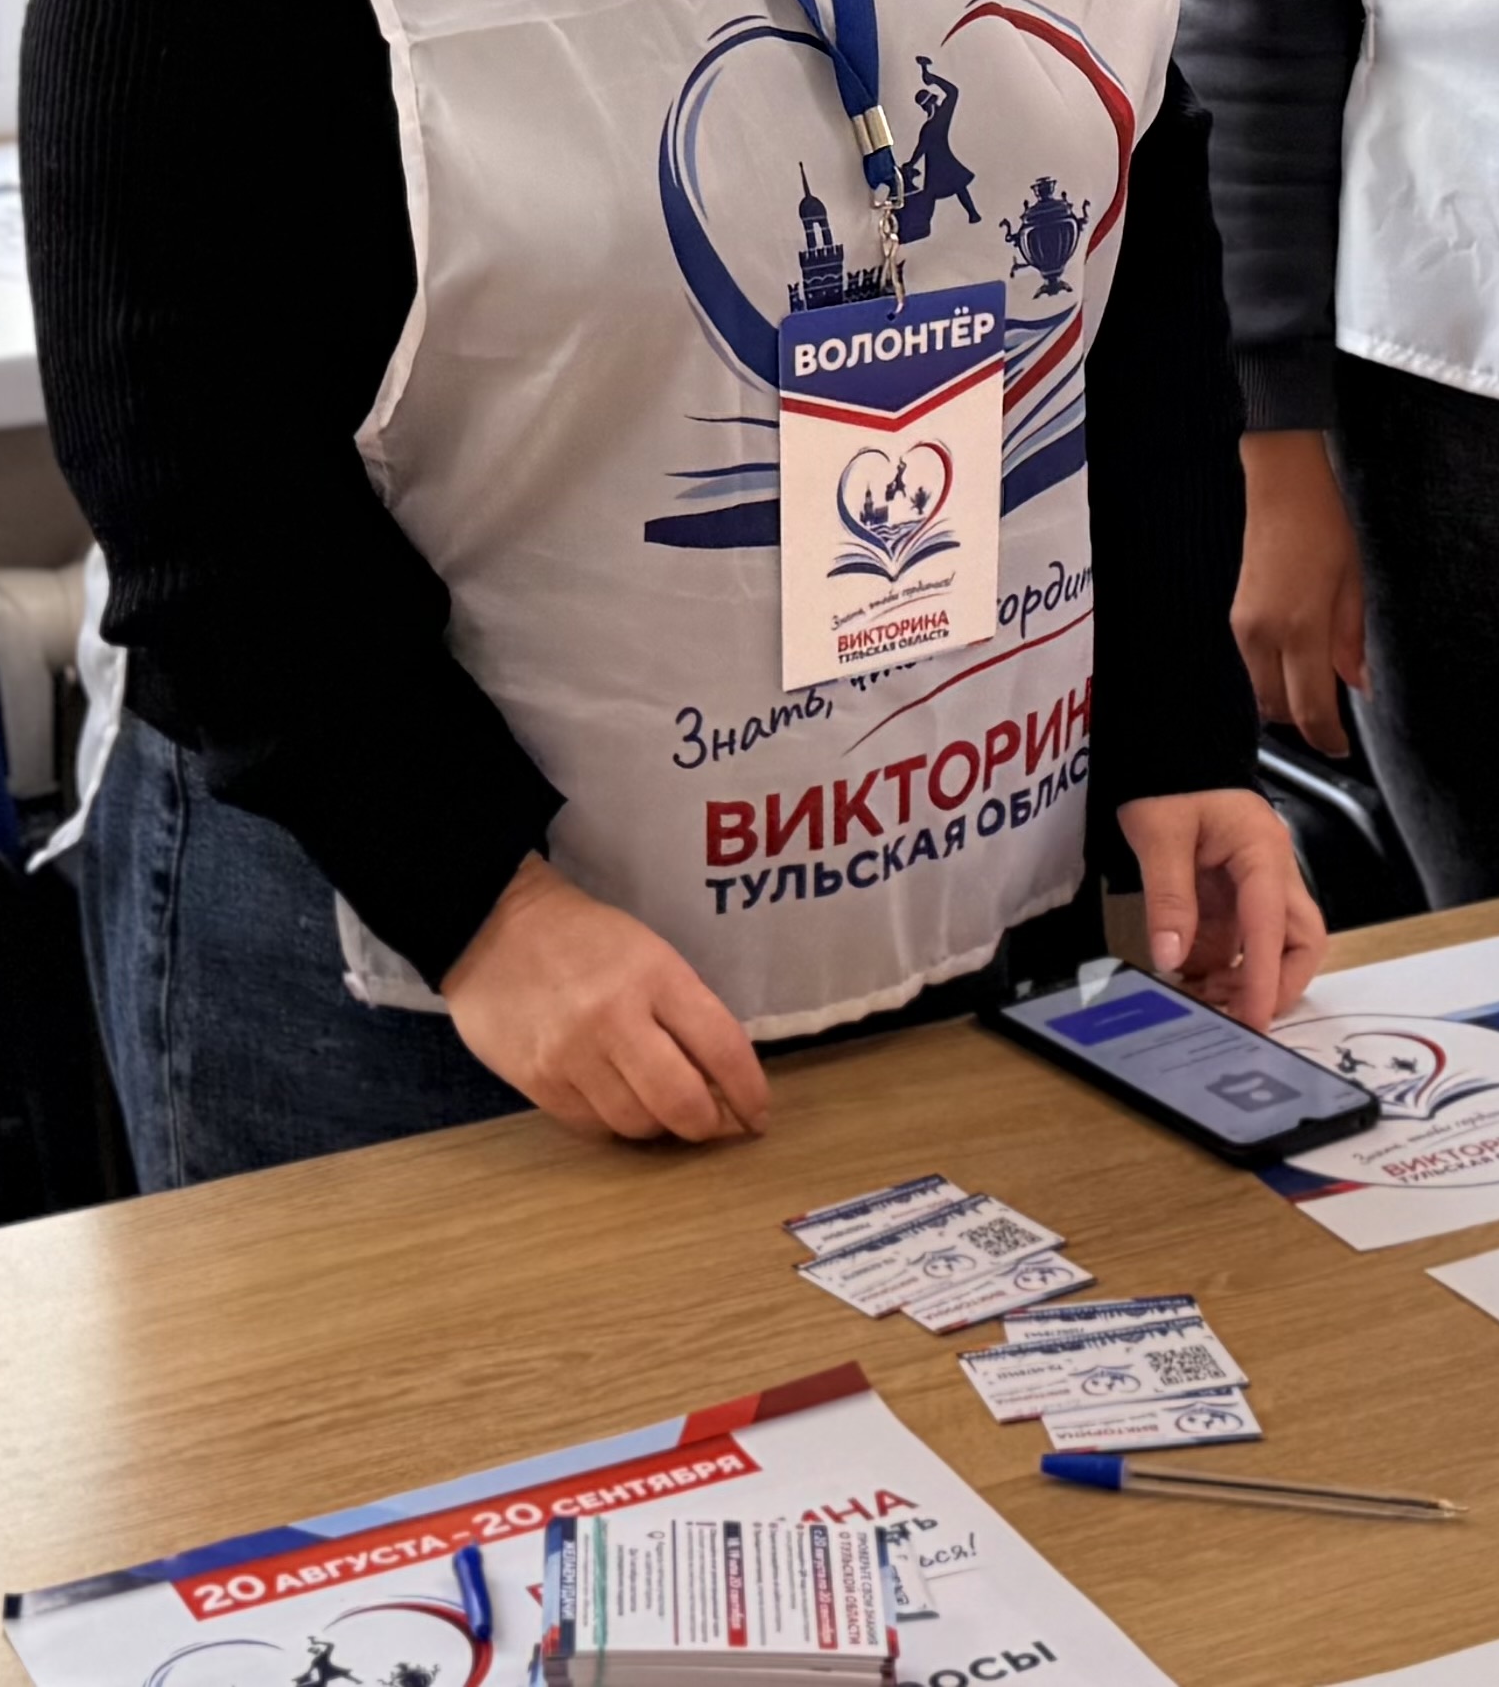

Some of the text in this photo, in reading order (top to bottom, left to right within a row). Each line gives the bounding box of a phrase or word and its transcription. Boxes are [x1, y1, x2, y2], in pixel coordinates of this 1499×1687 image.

[794, 306, 996, 377] ВОЛОНТЁР
[837, 609, 950, 654] ВИКТОРИНА
[838, 628, 950, 665] ТУЛЬСКАЯ ОБЛАСТЬ
[672, 688, 834, 770] Знать,
[705, 676, 1093, 867] ВИКТОРИН
[705, 746, 1091, 915] ТУЛЬСКАЯ ОБЛАС
[1397, 1155, 1494, 1185] ТУЛЬСКАЯ
[192, 1574, 267, 1613] 20
[273, 1525, 451, 1596] АВГУСТА
[471, 1501, 546, 1540] 20
[550, 1451, 746, 1519] СЕНТЯБРЯ
